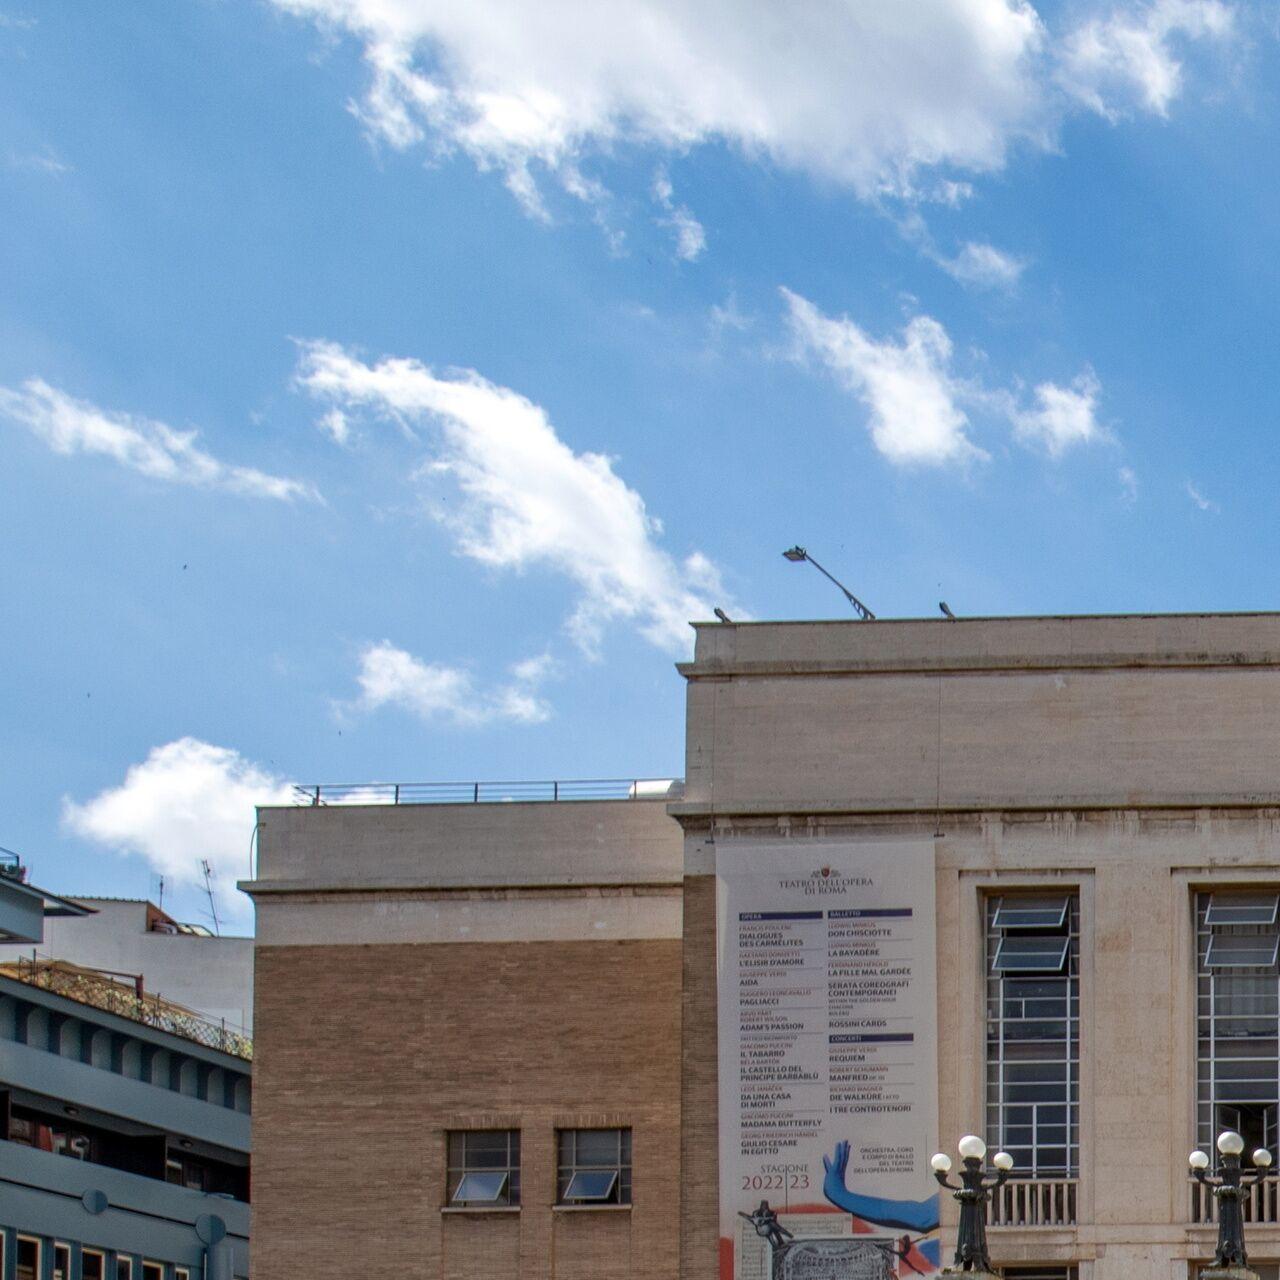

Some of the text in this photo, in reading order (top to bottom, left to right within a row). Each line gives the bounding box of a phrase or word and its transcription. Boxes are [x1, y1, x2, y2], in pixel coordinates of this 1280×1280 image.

[846, 929, 892, 937] CHISCIOTTE
[860, 981, 909, 989] COREOGRAFI
[828, 989, 896, 997] CONTEMPORANEI
[850, 1105, 911, 1113] CONTROTENORI
[778, 1119, 822, 1127] BUTTERFLY
[742, 1174, 809, 1190] 2022 23
